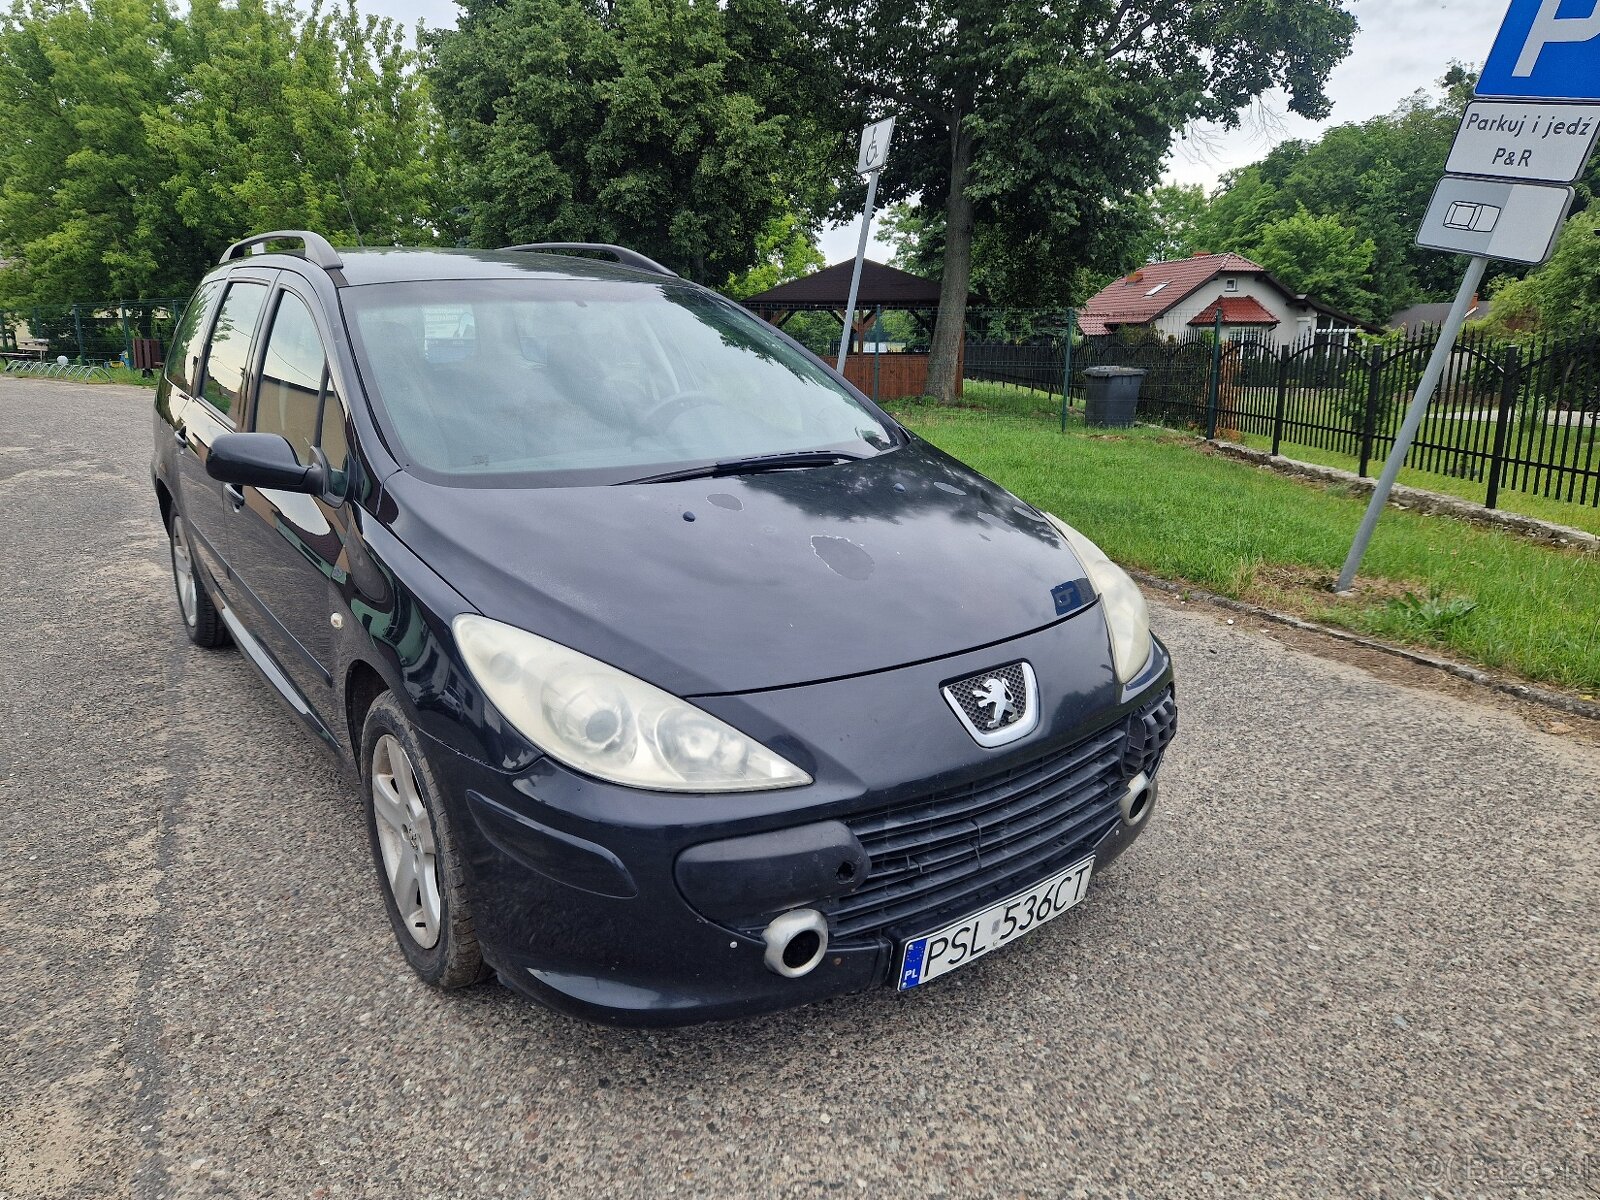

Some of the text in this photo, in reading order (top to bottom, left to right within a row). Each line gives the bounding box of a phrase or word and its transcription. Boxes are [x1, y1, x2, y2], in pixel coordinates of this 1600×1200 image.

[1466, 113, 1594, 139] Parkuj i jedź
[1492, 148, 1532, 167] P&R
[924, 865, 1090, 977] PSL 536CT
[904, 970, 918, 981] PL
